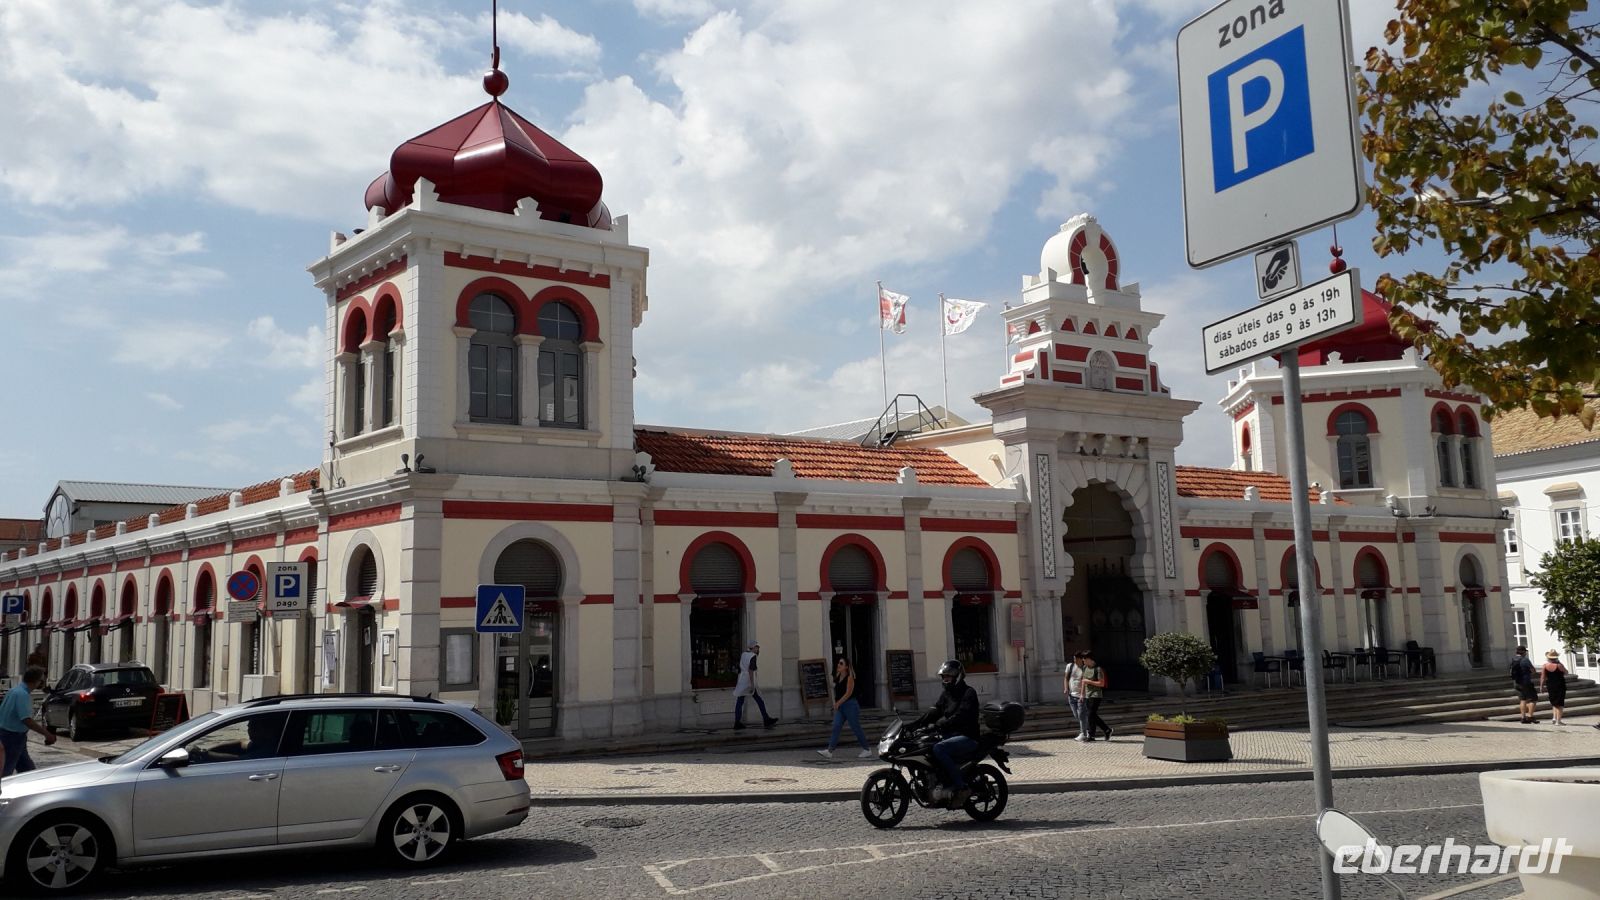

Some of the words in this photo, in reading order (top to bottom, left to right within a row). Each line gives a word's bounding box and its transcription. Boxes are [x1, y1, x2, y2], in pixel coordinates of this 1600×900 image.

[1219, 0, 1285, 48] zona
[1228, 58, 1285, 174] P
[1213, 330, 1232, 344] dias
[1237, 318, 1261, 335] úteis
[1266, 310, 1284, 324] das
[1289, 303, 1297, 315] 9
[1303, 298, 1315, 310] às
[1321, 287, 1340, 303] 19h
[1219, 336, 1257, 359] sábados
[1263, 330, 1280, 343] das
[1286, 323, 1293, 334] 9
[1299, 318, 1311, 330] às
[1317, 308, 1336, 324] 13h
[7, 597, 20, 612] P
[276, 600, 298, 608] pago
[279, 575, 296, 597] P
